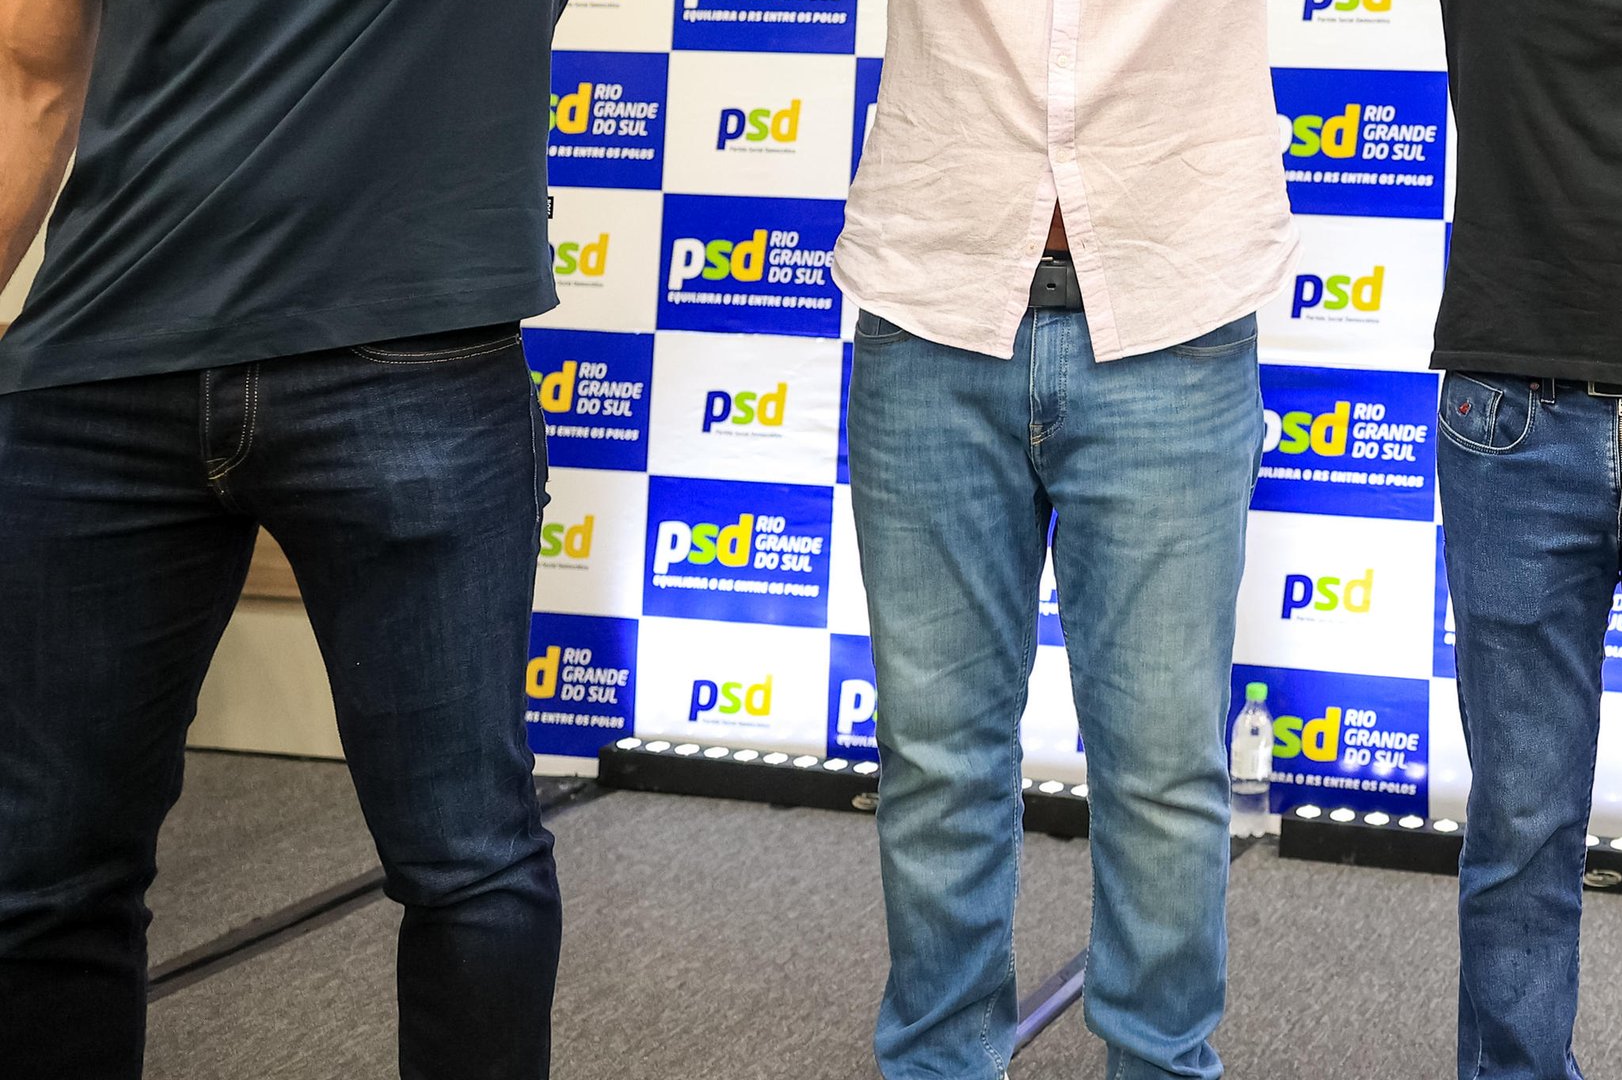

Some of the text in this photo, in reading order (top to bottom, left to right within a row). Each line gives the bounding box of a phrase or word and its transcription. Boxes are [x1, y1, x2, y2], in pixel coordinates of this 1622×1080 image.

[594, 84, 622, 100] RIO
[594, 102, 658, 120] GRANDE
[1364, 105, 1395, 122] RIO
[593, 119, 647, 136] DO SUL
[716, 99, 801, 150] psd
[1364, 124, 1436, 142] GRANDE
[1363, 143, 1425, 161] DO SUL
[770, 231, 799, 247] RIO
[668, 229, 768, 290] psd
[769, 249, 834, 268] GRANDE
[768, 267, 825, 285] DO SUL
[1291, 266, 1384, 318] psd
[579, 362, 607, 379] RIO
[578, 378, 643, 401] GRANDE
[577, 398, 632, 416] DO SUL
[702, 383, 787, 433] psd
[1354, 403, 1385, 421] RIO
[1353, 423, 1427, 444] GRANDE
[1352, 441, 1415, 461] DO SUL
[756, 516, 785, 533] RIO
[654, 514, 754, 574] psd
[755, 534, 822, 554] GRANDE
[754, 552, 812, 572] DO SUL
[1281, 568, 1373, 619] psd
[689, 675, 773, 721] psd
[1345, 709, 1376, 727] RIO
[1345, 729, 1419, 751] GRANDE
[1343, 748, 1408, 771] DO SUL
